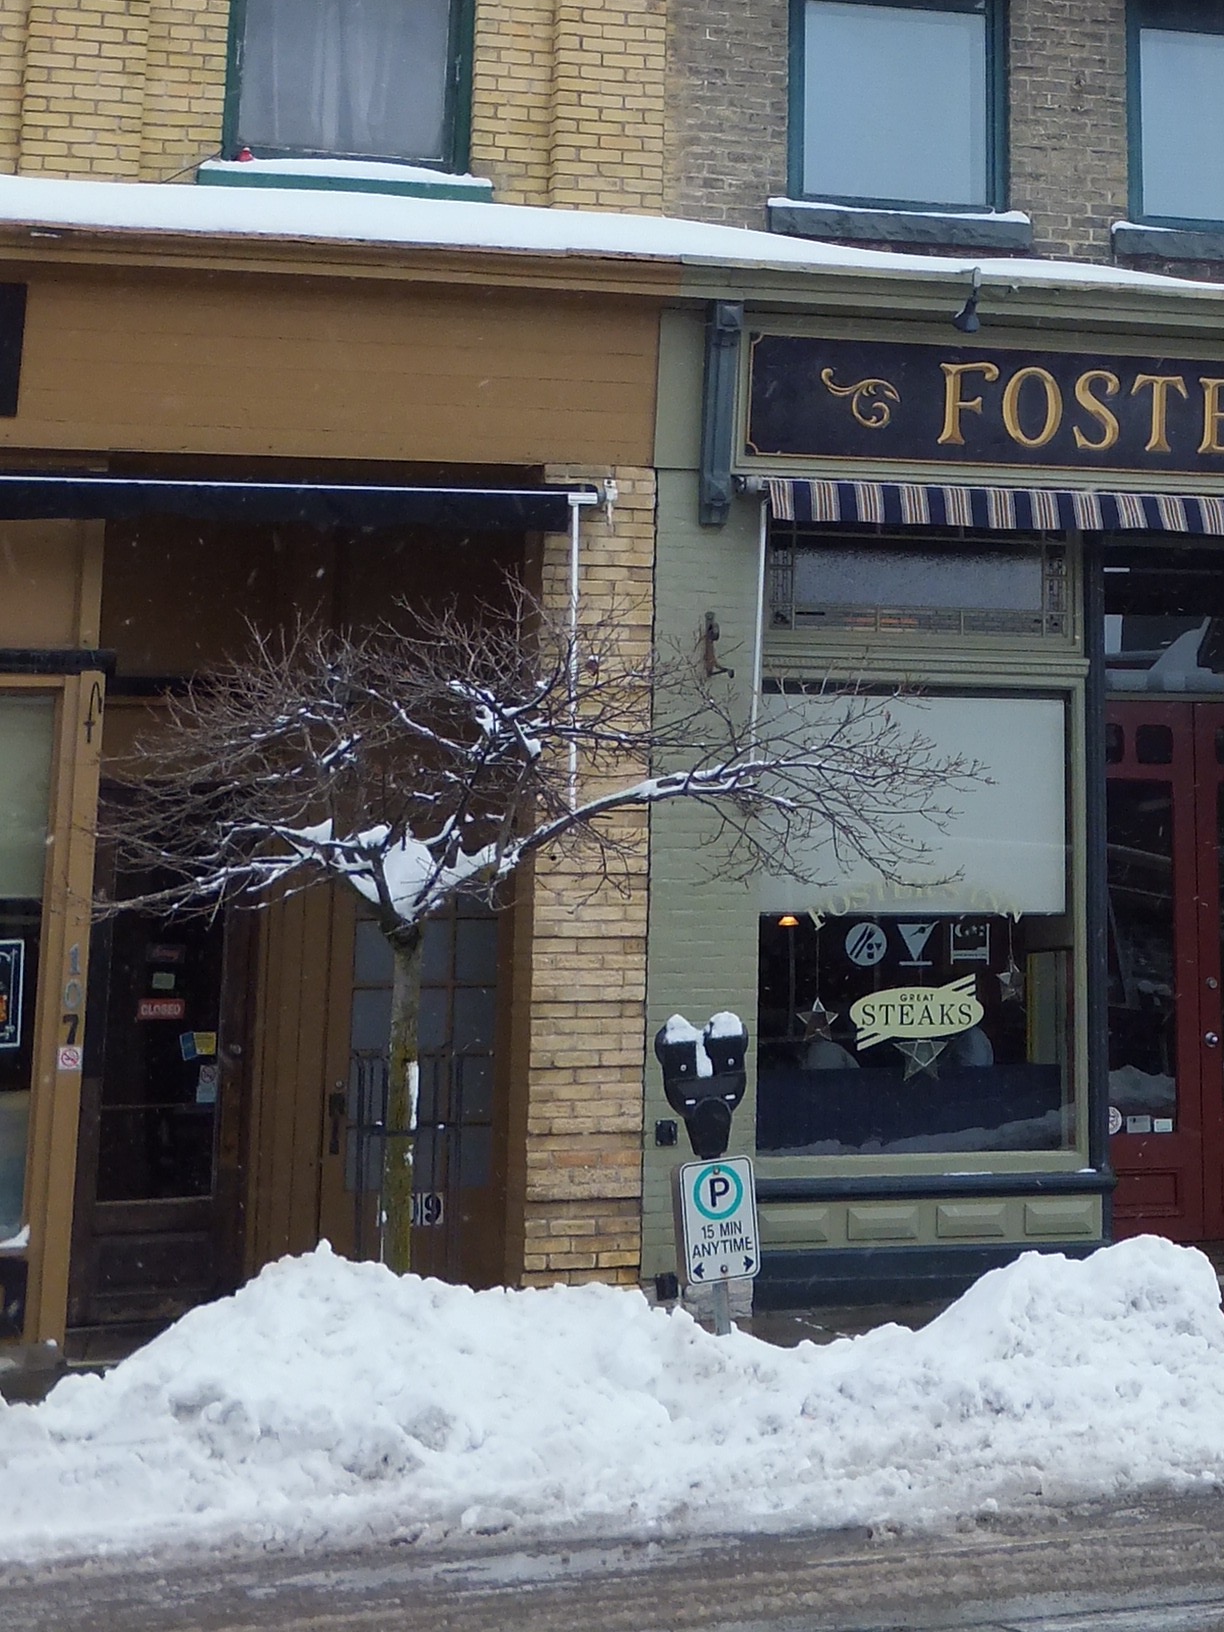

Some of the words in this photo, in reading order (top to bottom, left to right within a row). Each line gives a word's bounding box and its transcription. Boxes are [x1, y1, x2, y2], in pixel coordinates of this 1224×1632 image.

[900, 993, 935, 1003] GREAT
[140, 1004, 182, 1016] CLOSED
[861, 1002, 973, 1026] STEAKS
[708, 1176, 730, 1208] P
[701, 1223, 715, 1240] 15
[719, 1220, 743, 1238] MIN
[692, 1236, 754, 1259] ANYTIME
